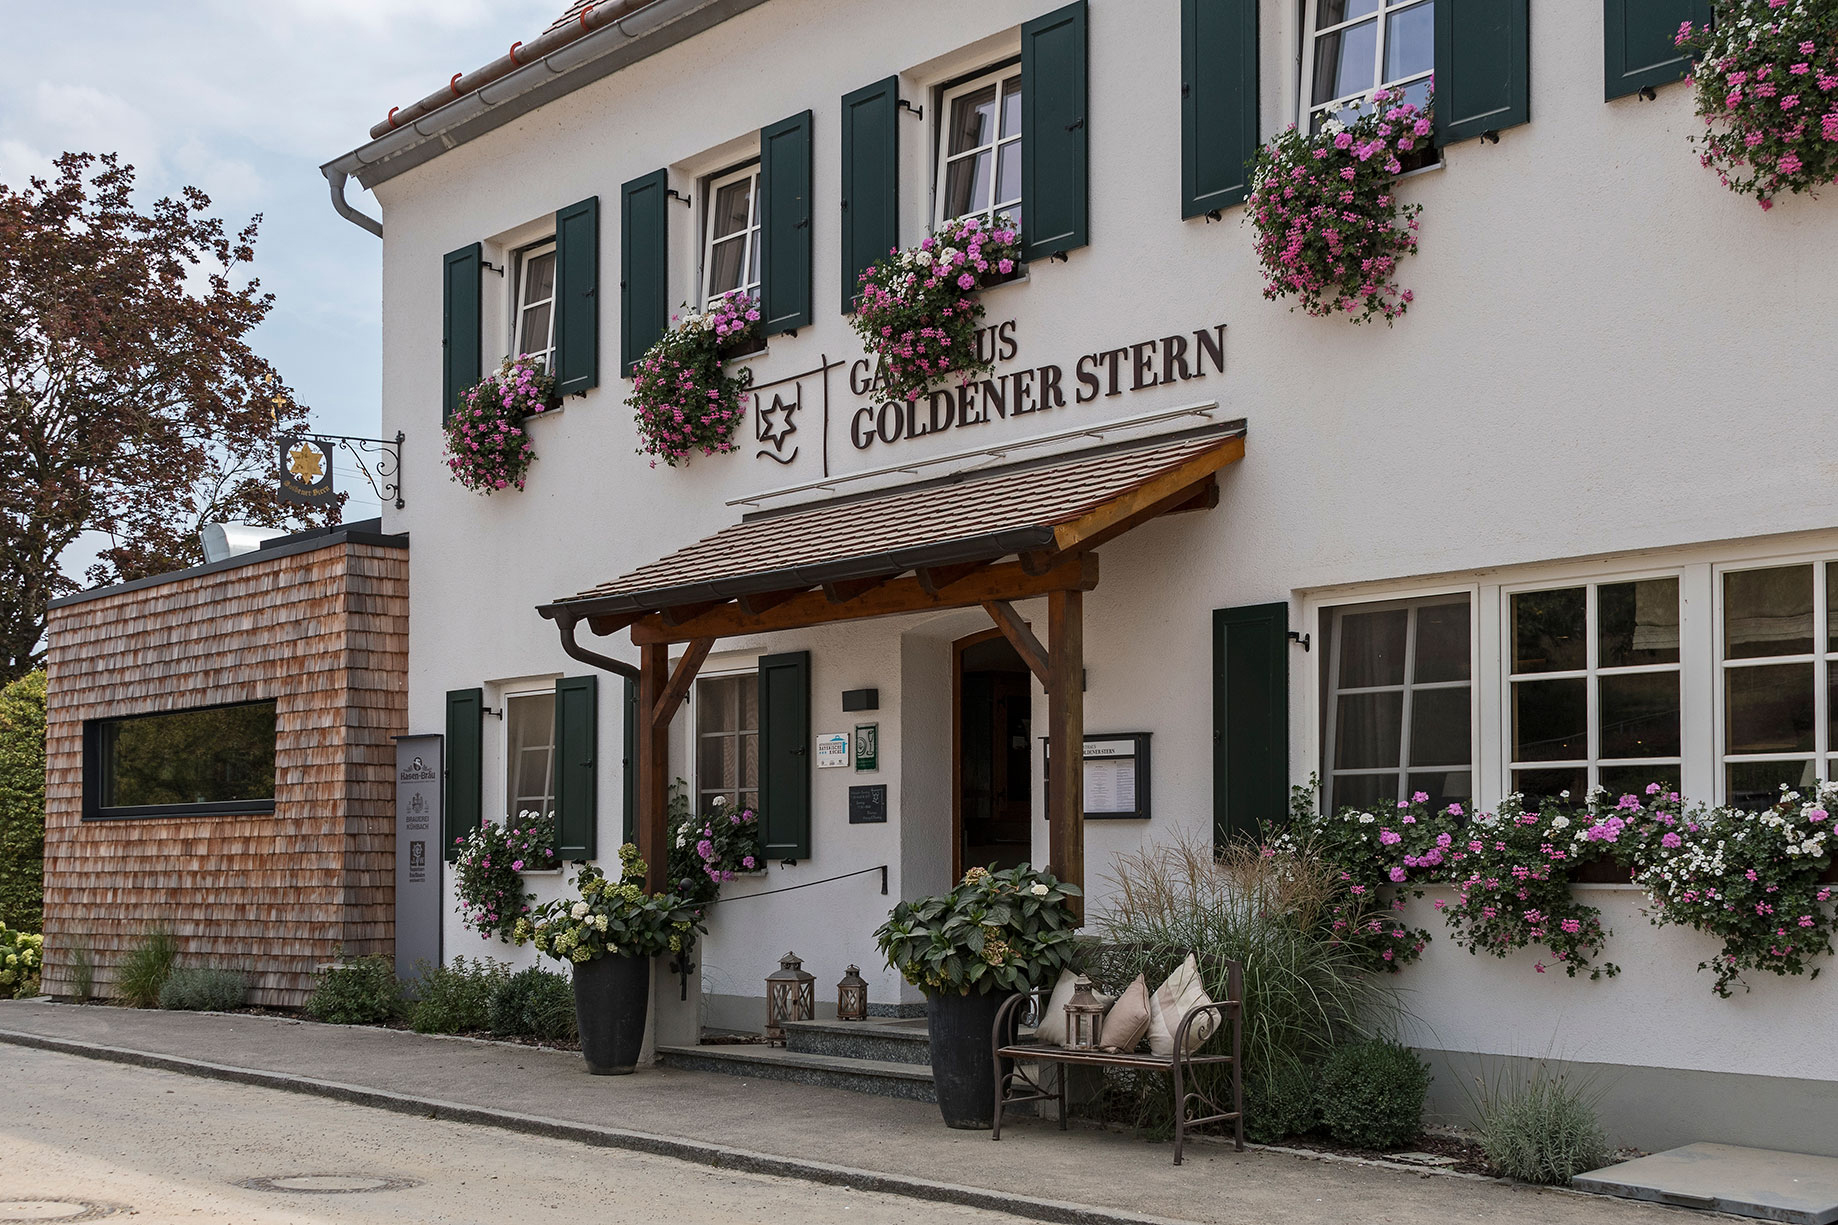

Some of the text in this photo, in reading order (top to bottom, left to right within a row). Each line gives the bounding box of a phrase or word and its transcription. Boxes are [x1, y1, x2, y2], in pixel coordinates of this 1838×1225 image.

[850, 320, 1018, 396] GAUS
[851, 323, 1228, 450] GOLDENER STERN
[400, 770, 436, 781] Hasen-Bräu
[405, 815, 430, 823] BRAUEREI
